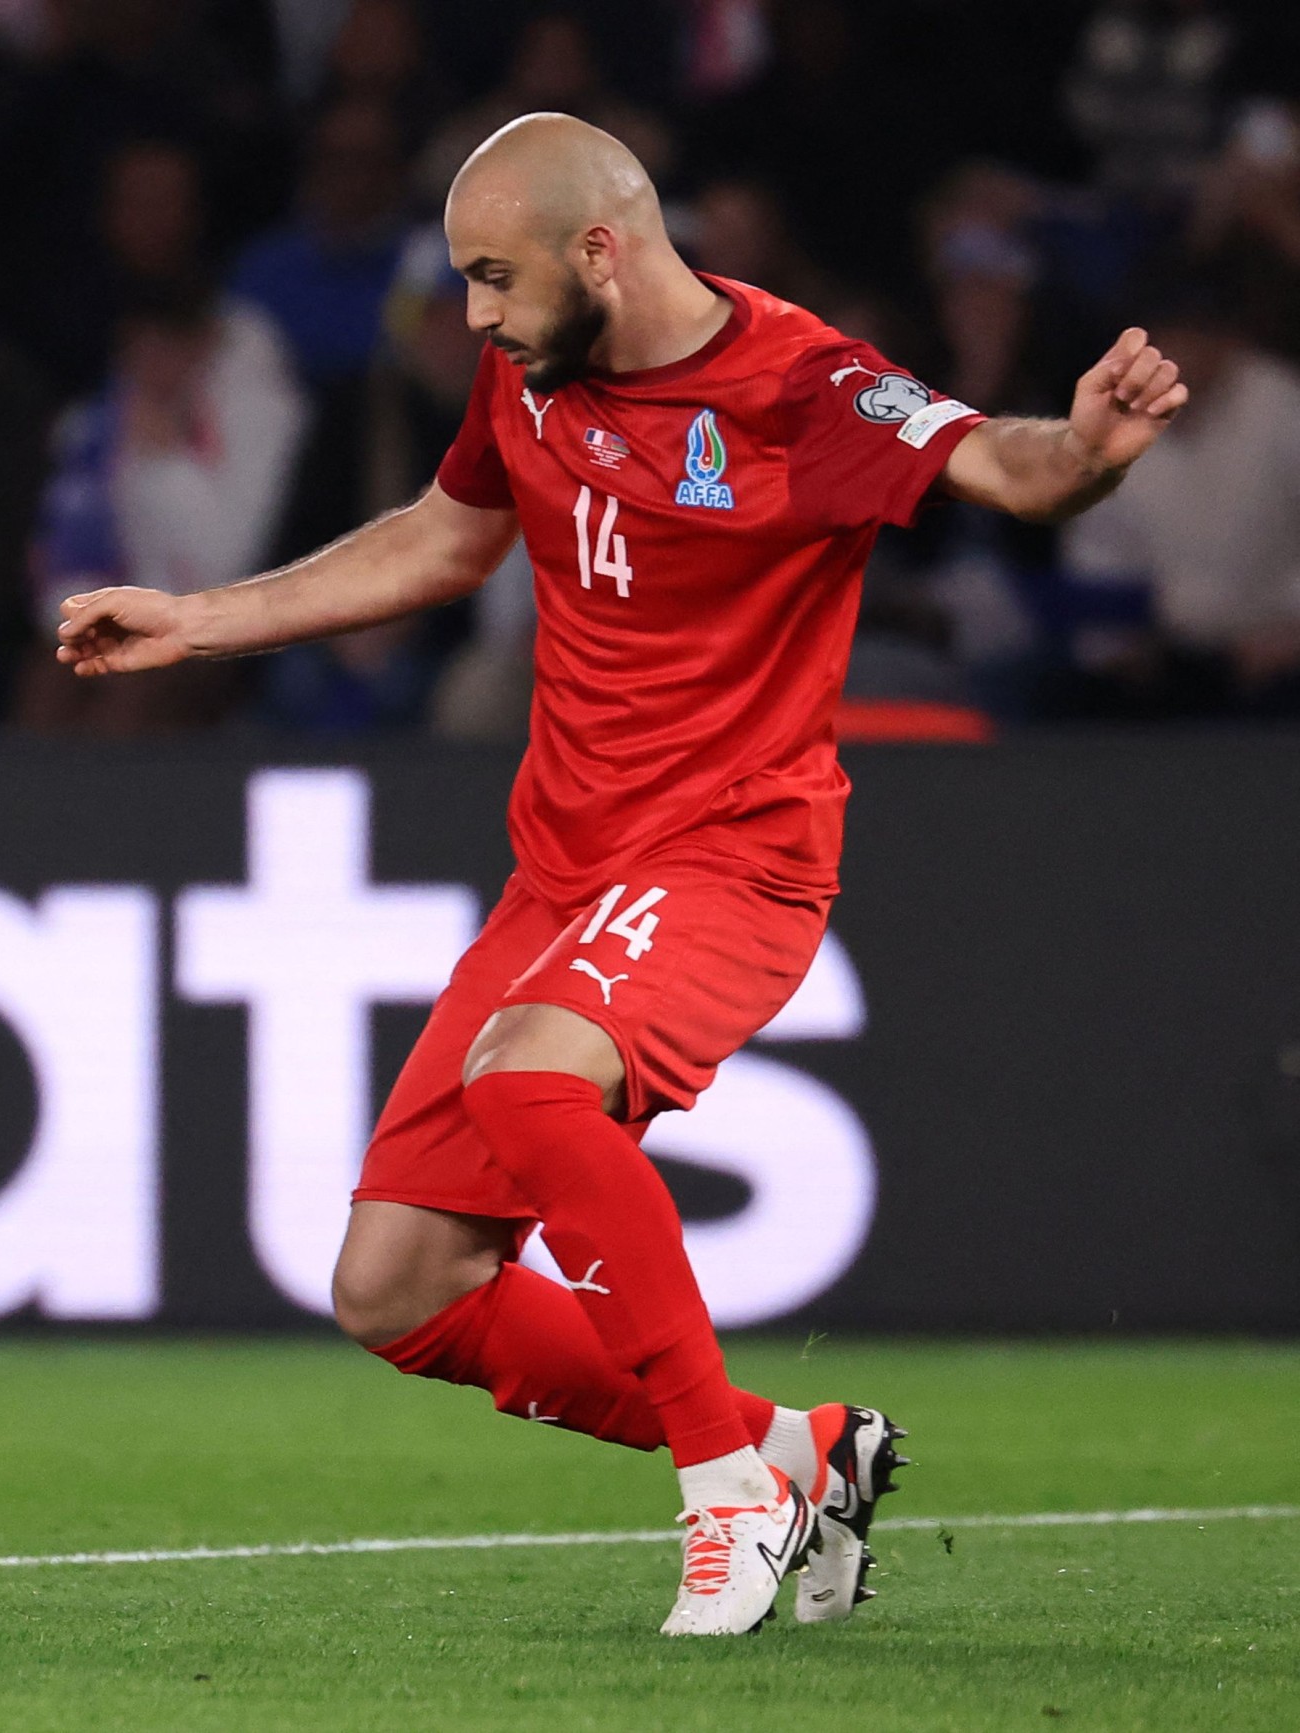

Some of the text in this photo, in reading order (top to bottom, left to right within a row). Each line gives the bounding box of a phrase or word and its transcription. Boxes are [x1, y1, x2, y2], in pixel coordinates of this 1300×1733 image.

[675, 481, 734, 509] AFFA
[572, 485, 633, 598] 14
[578, 884, 669, 961] 14
